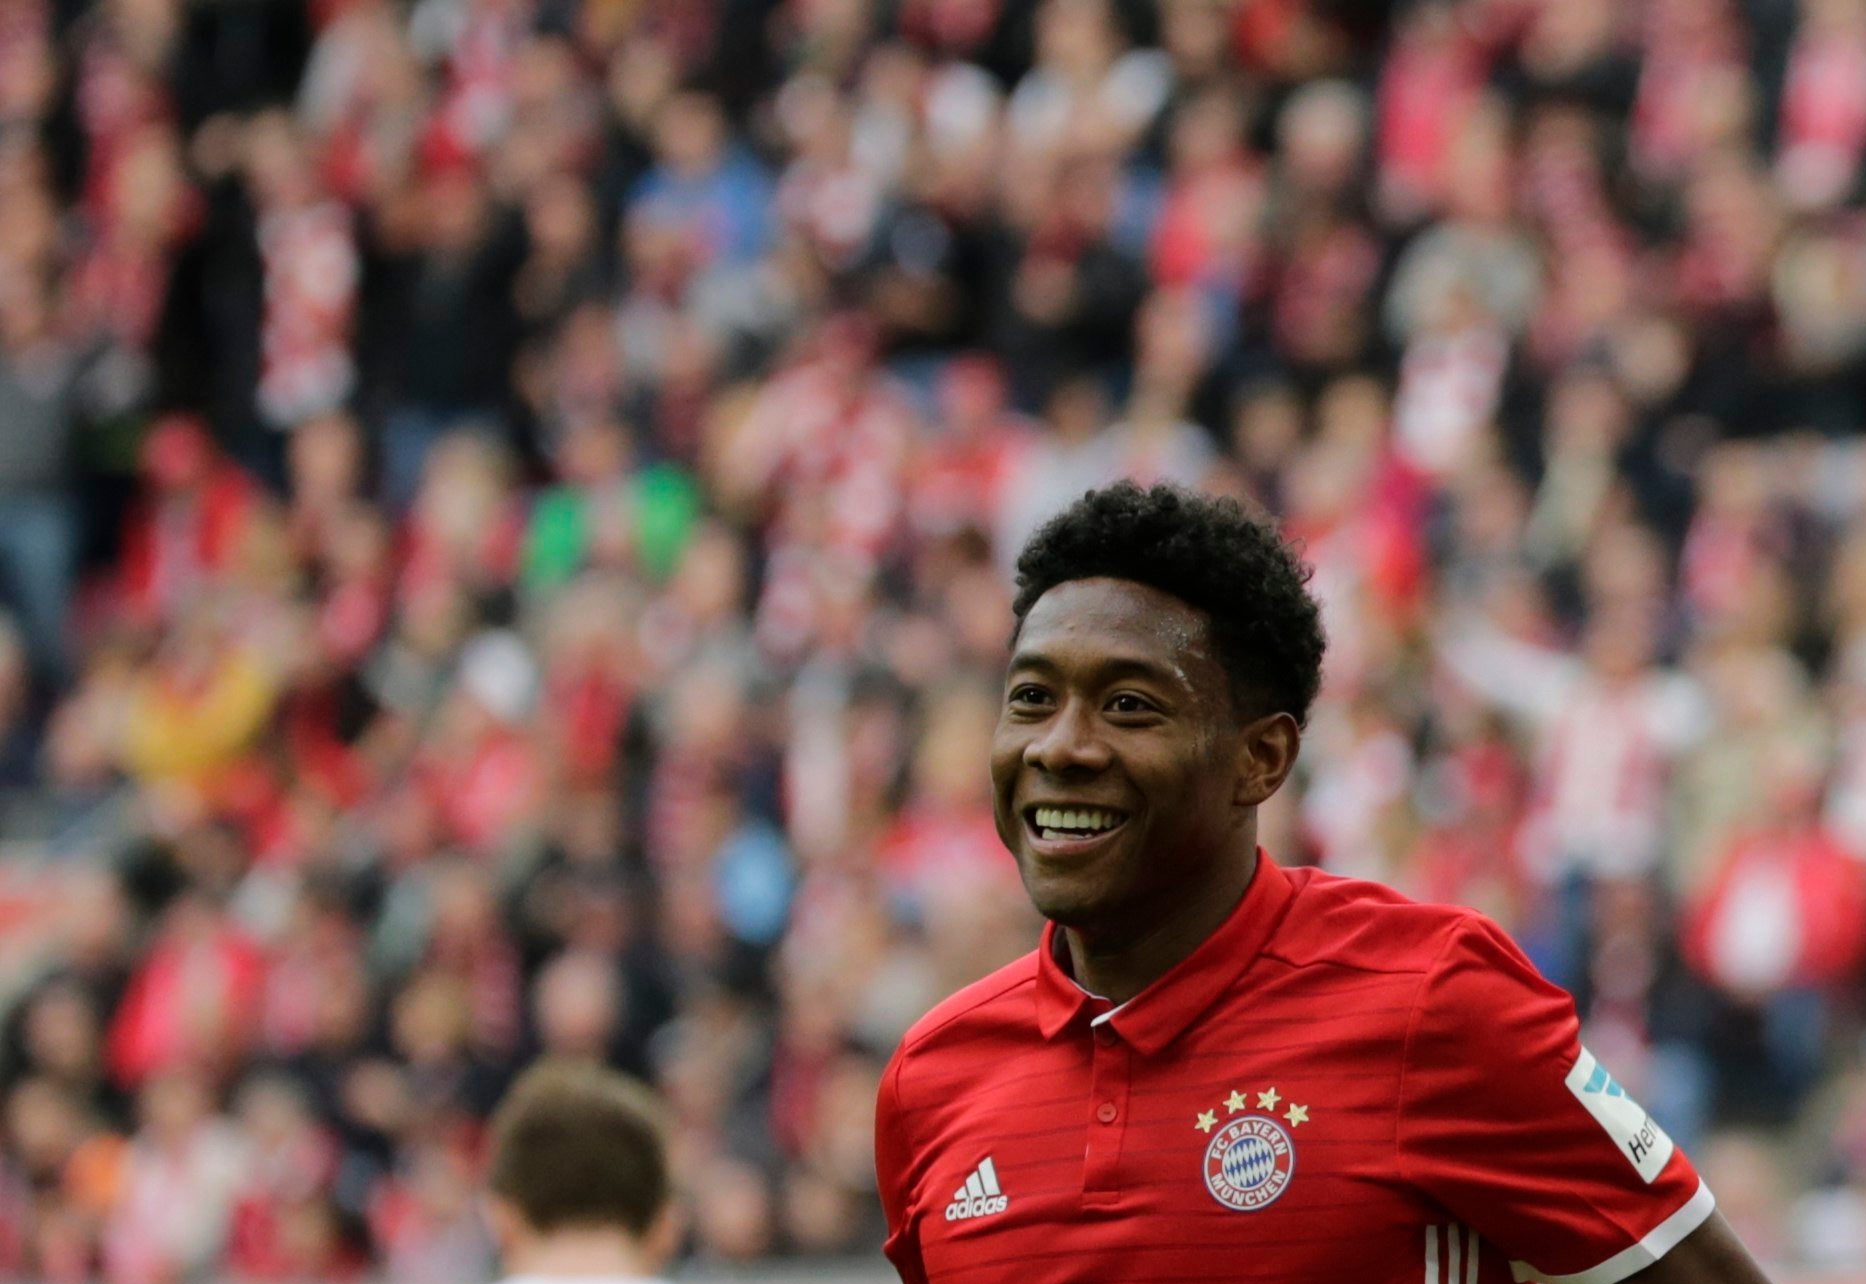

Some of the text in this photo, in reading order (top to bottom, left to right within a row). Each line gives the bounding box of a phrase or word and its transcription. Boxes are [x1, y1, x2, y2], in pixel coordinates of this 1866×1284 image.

[1210, 1121, 1288, 1160] FC BAYERN
[945, 1194, 1008, 1222] adidas
